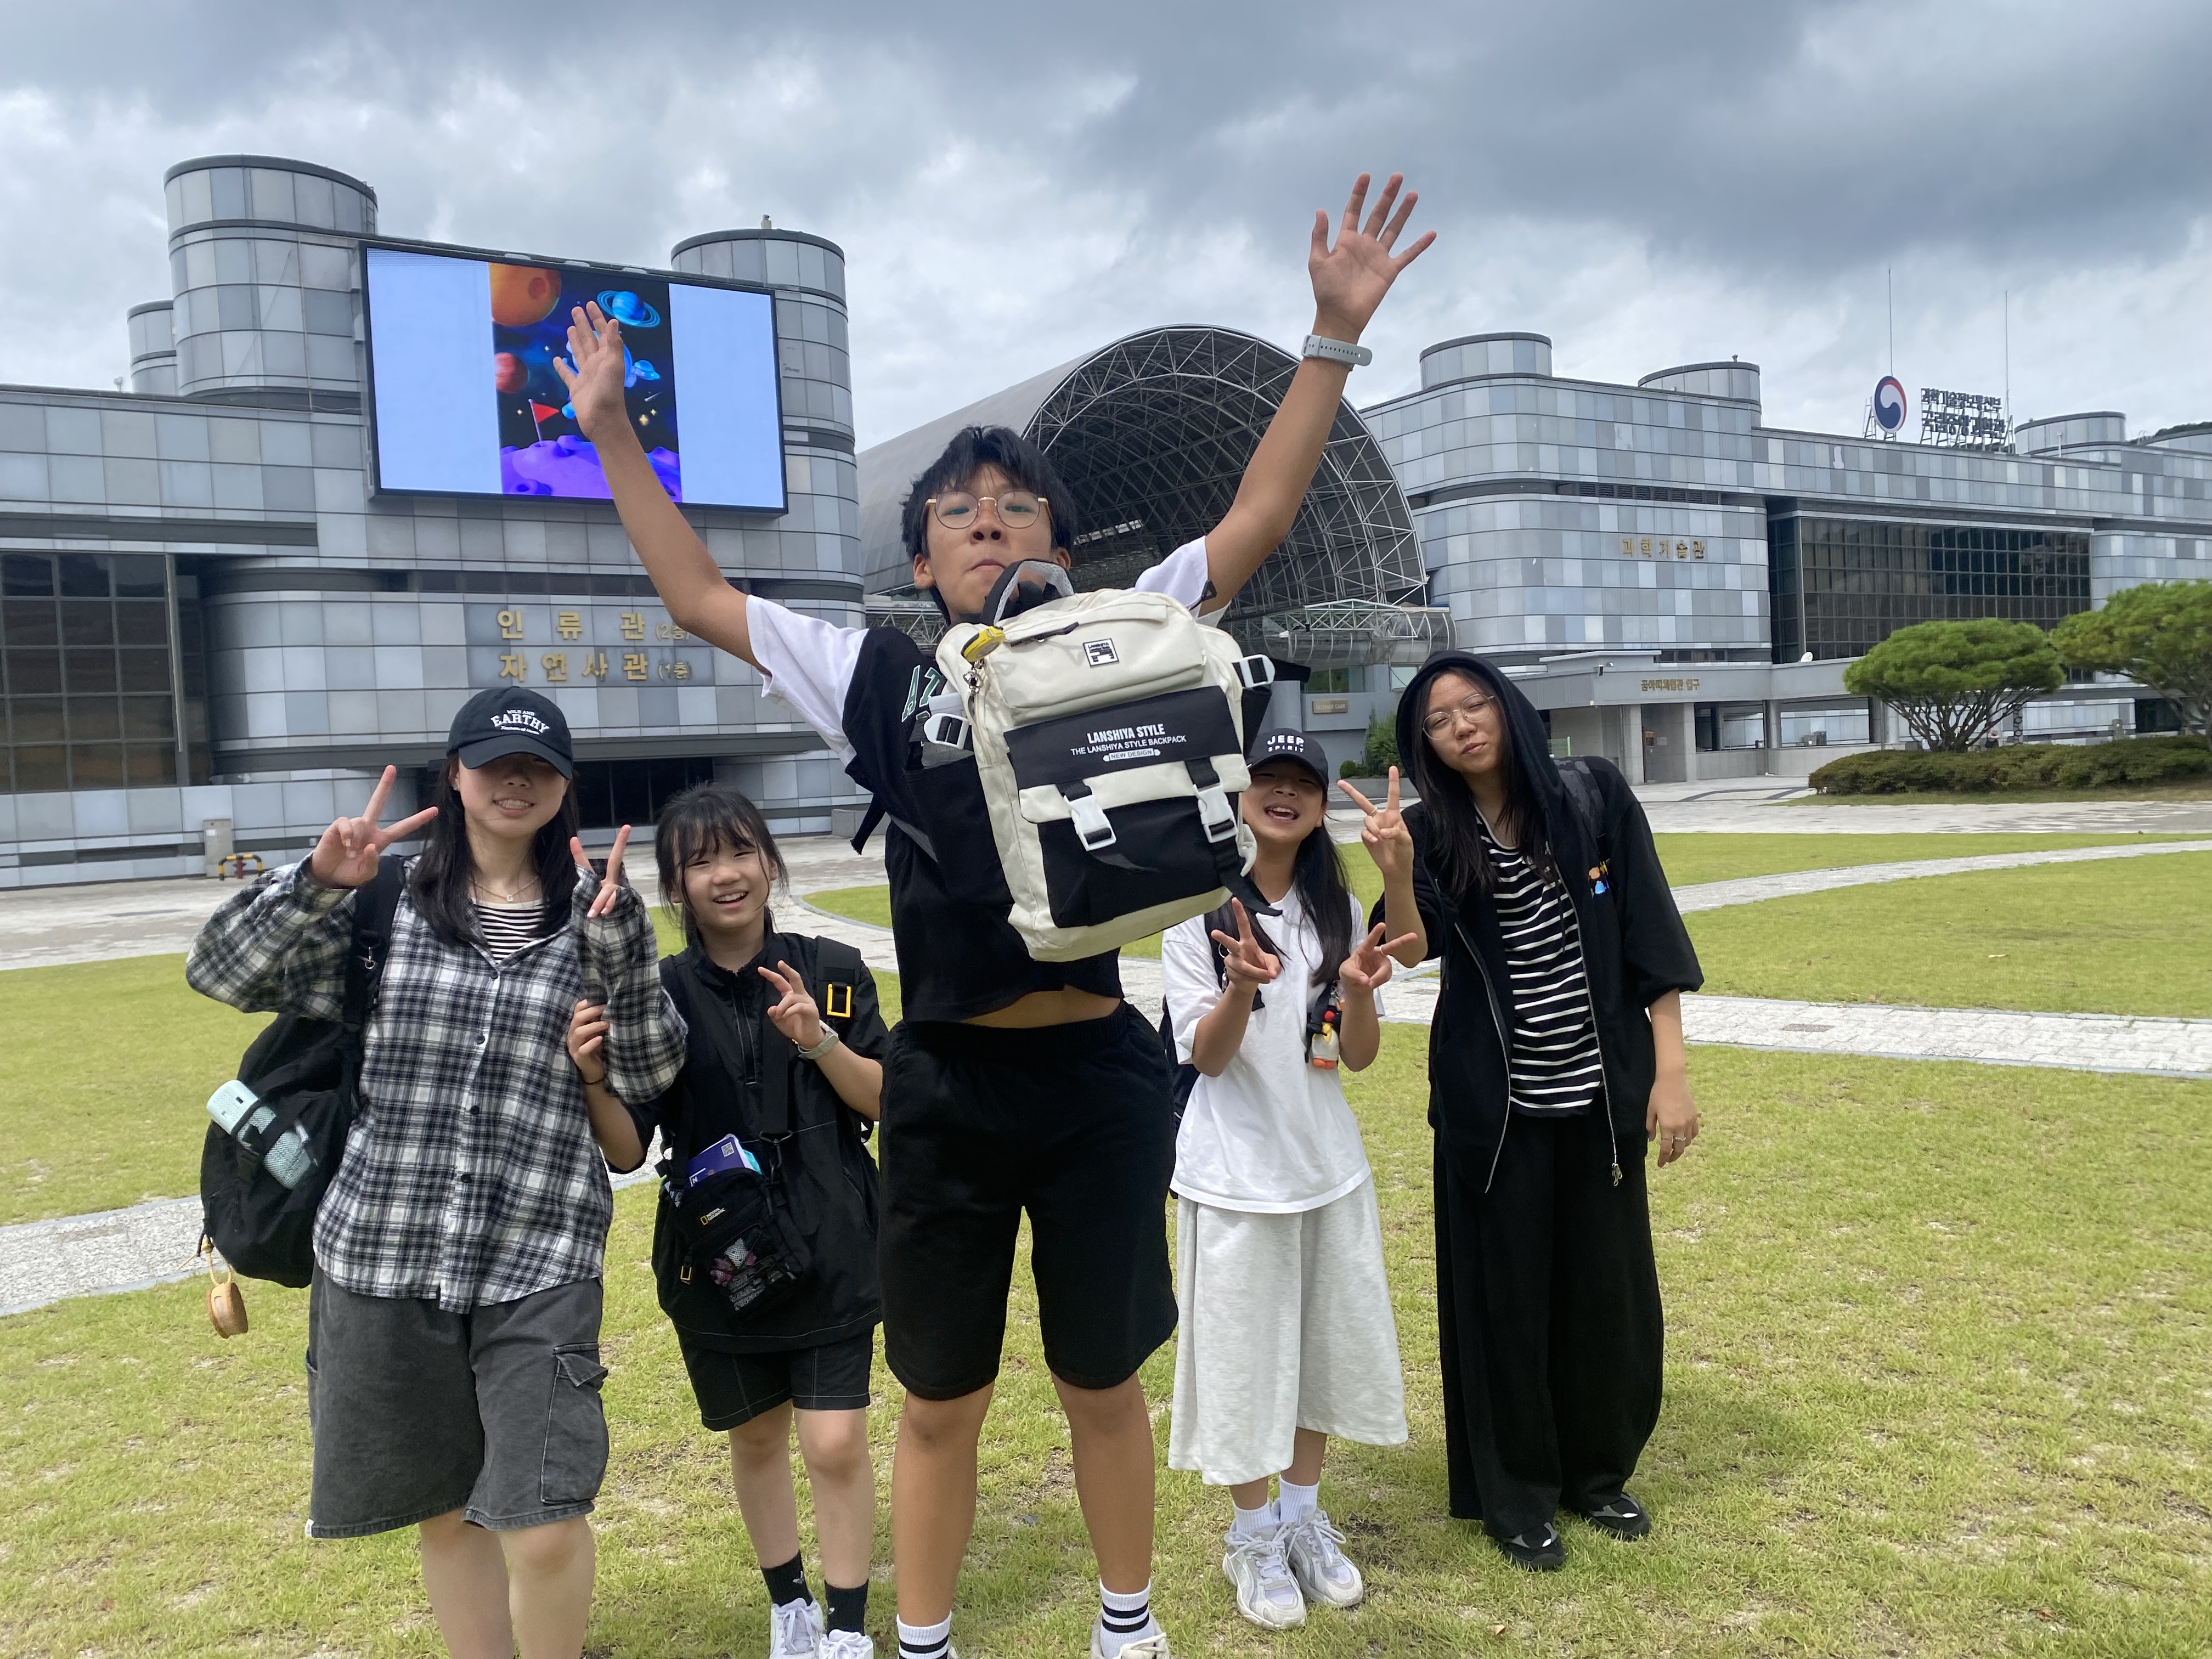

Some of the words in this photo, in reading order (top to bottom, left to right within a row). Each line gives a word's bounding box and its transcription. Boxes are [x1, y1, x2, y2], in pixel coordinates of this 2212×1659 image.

[1622, 538, 1705, 559] 과학기술관
[499, 653, 648, 682] 자연사관
[1686, 679, 1700, 691] 입구
[490, 714, 550, 733] EARTHY
[1087, 727, 1136, 744] LANSHIYA
[1137, 723, 1165, 738] STYLE
[1267, 735, 1304, 745] JEEP
[1070, 747, 1086, 755] THE
[1087, 742, 1124, 754] LANSHIYA
[1124, 739, 1148, 749] STYLE
[1148, 735, 1187, 746] BACKPACK
[1110, 751, 1126, 760] NEW
[1127, 749, 1153, 758] DESIGN
